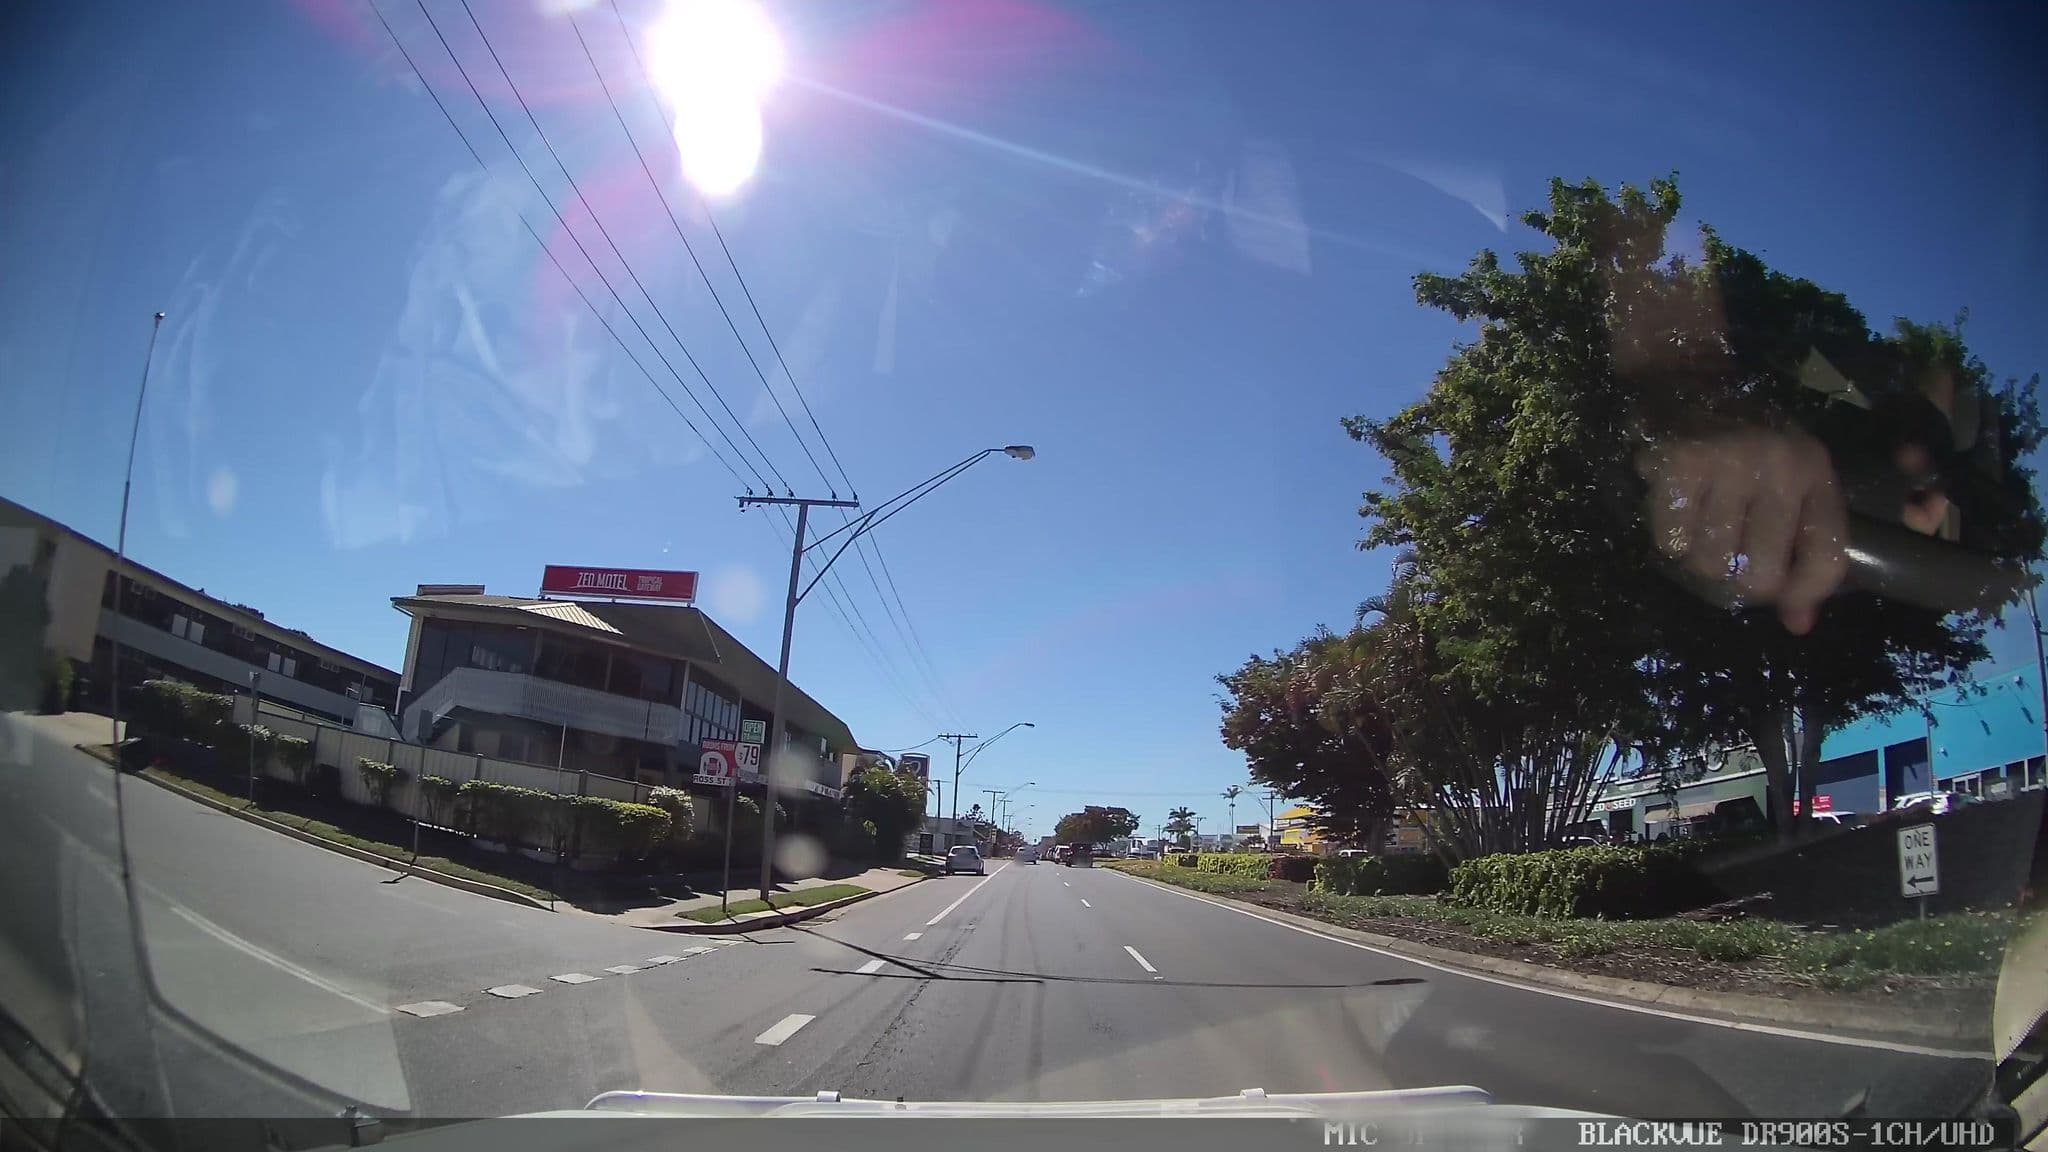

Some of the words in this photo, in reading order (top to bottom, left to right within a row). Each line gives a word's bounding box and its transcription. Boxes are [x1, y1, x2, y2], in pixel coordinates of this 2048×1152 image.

[577, 573, 595, 587] ZED
[597, 573, 627, 590] MOTEL
[693, 775, 714, 784] ROSS
[717, 777, 727, 785] ST
[1613, 798, 1636, 810] SEED
[1904, 832, 1930, 849] ONE
[1904, 853, 1931, 870] WAY
